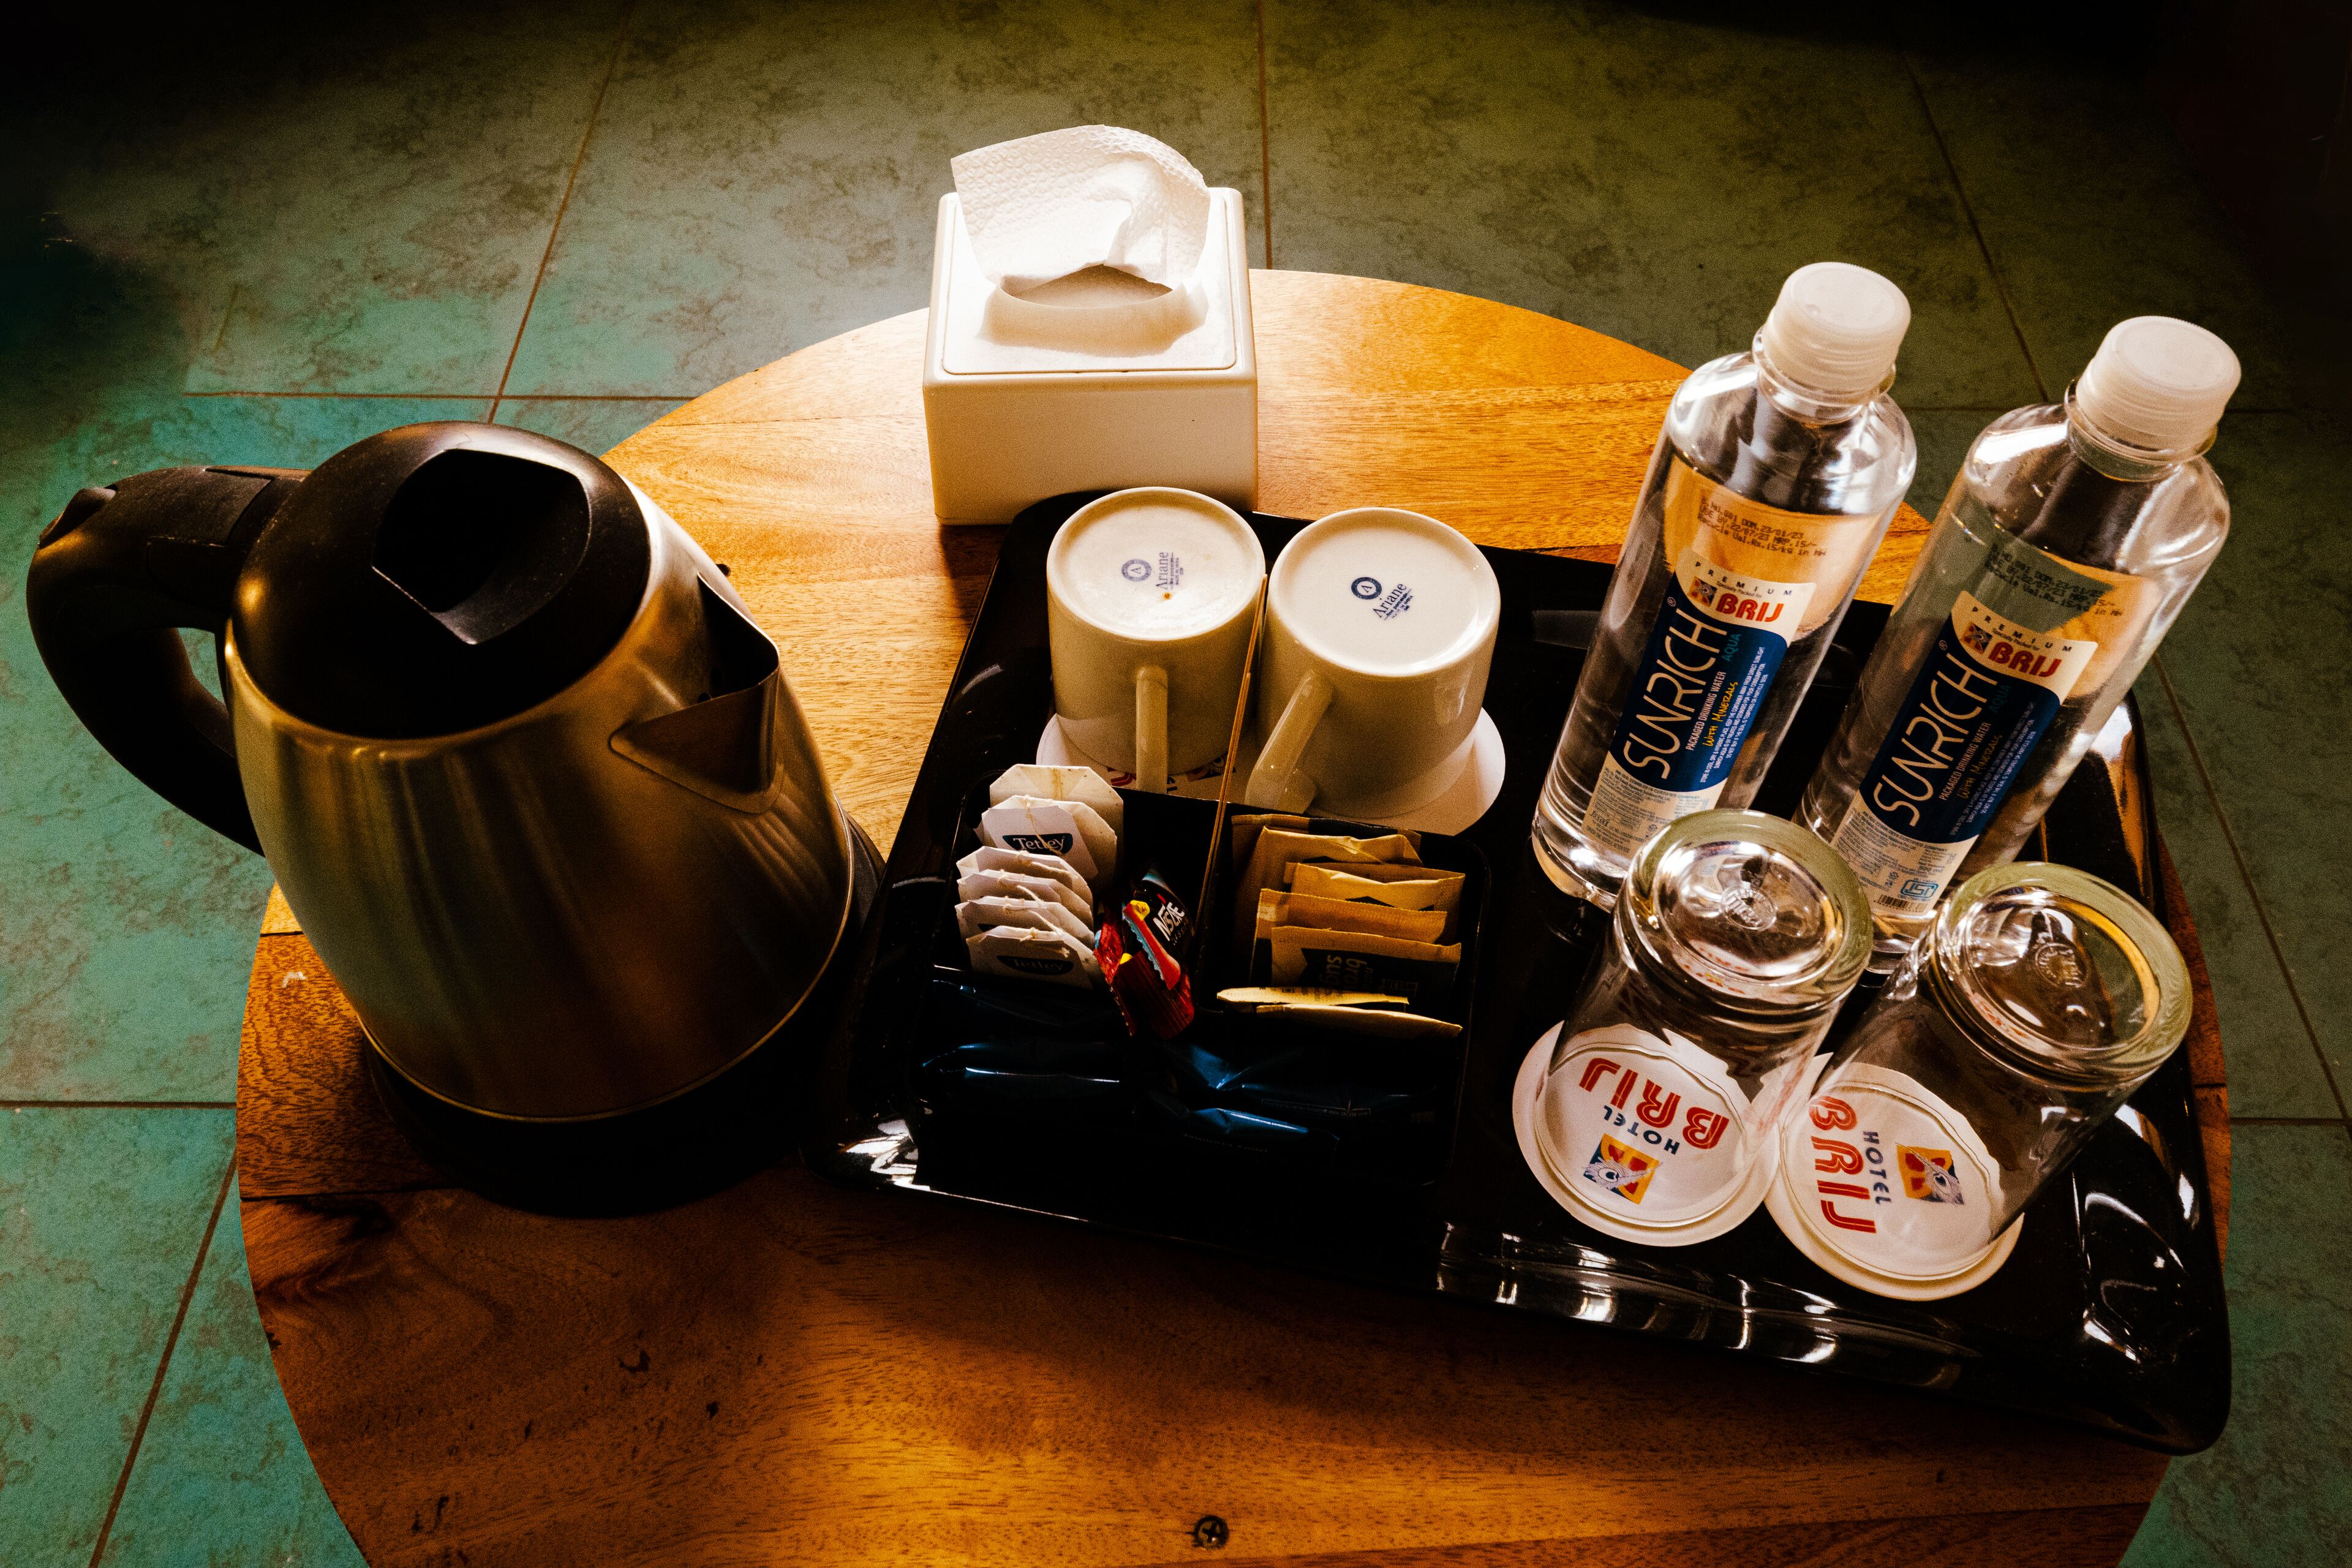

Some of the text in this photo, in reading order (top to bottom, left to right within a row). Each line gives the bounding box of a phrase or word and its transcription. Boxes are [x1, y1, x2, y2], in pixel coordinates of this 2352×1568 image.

[1156, 552, 1169, 589] Ariane
[1695, 561, 1793, 597] PREMIUM
[1373, 584, 1407, 618] Ariane
[1716, 593, 1784, 624] BRIJ
[1722, 633, 1742, 661] AQUA
[1971, 606, 2072, 652] PREMIUM
[1988, 641, 2062, 679] BRIJ
[1623, 608, 1728, 780] SUNRICH
[1686, 671, 1727, 751] PACKAGED DRINKING WATER
[1702, 681, 1738, 747] WITH MINERALS
[1873, 653, 1999, 827] SUNRICH
[1939, 722, 1992, 801] PACKAGED DRINKING WATER
[1970, 735, 2003, 775] MINERALS
[1012, 836, 1065, 851] Tetley
[1013, 959, 1063, 973] Tetley
[1579, 1058, 1730, 1149] BRIJ
[1602, 1104, 1680, 1155] HOTEL
[1808, 1095, 1877, 1234] BRIJ
[1862, 1131, 1893, 1205] HOTEL
